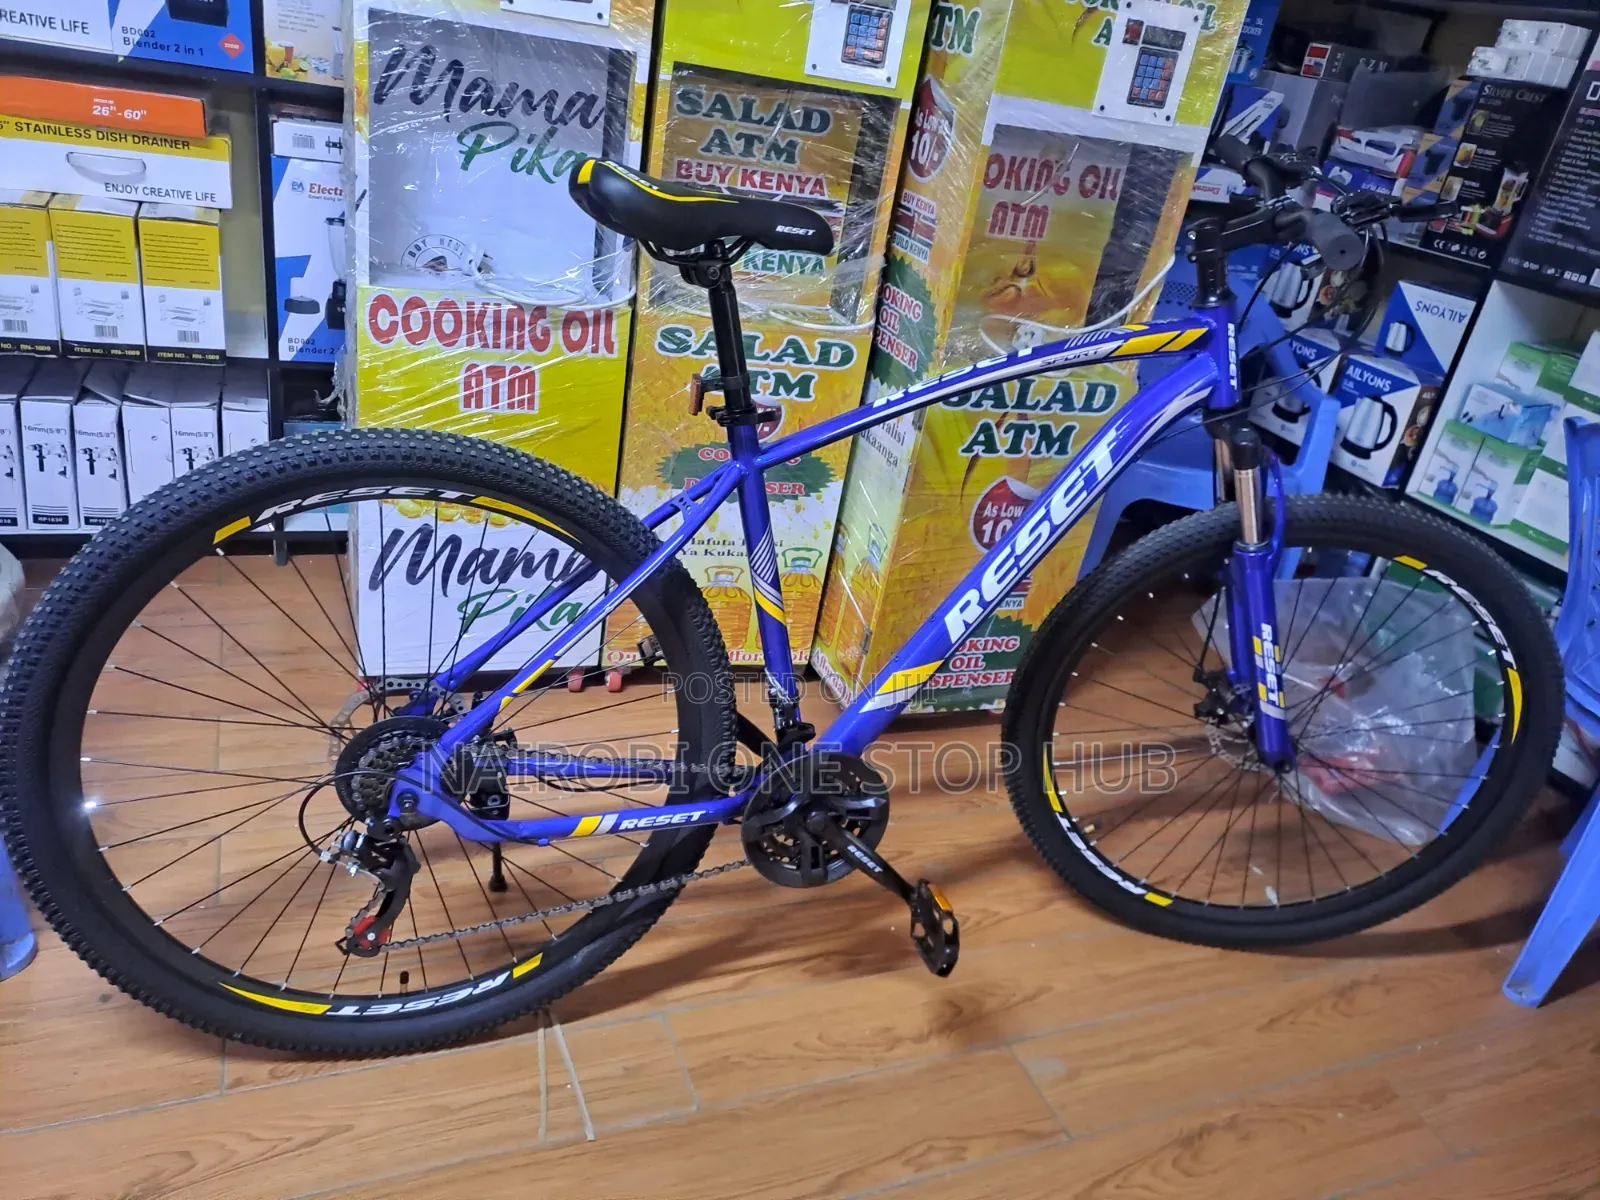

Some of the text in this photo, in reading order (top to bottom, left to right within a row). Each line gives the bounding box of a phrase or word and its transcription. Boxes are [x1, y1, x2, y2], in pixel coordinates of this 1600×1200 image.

[60, 18, 90, 35] LIFE
[121, 25, 156, 38] BD002
[932, 7, 976, 53] TM
[123, 36, 204, 56] Blender 2 in 1
[373, 44, 607, 130] Mama
[676, 87, 834, 134] SALAD
[15, 121, 92, 140] STAINLESS
[96, 130, 128, 143] DISH
[132, 134, 190, 150] DRAINER
[699, 128, 803, 165] ATM
[911, 130, 939, 170] 10/-
[105, 183, 217, 204] ENJOY CREATIVE LIFE
[675, 159, 829, 198] BUY KENYA
[917, 197, 935, 215] KENYA
[988, 201, 1049, 238] ATM
[775, 225, 816, 236] RESET
[743, 251, 827, 275] KENYA
[877, 283, 922, 321] OKING
[1415, 299, 1468, 324] AILYONS
[368, 294, 618, 355] COOKING OIL
[880, 308, 899, 333] OIL
[288, 337, 316, 346] BD002
[288, 345, 336, 355] Blender 2
[1039, 346, 1102, 367] SPORT
[1227, 322, 1238, 391] RESET
[463, 362, 538, 411] ATM
[1346, 364, 1393, 392] AILYONS
[961, 420, 1079, 457] ATM
[254, 485, 476, 523] RESET
[983, 501, 1025, 518] As Low
[944, 426, 1126, 644] RESET
[1000, 599, 1023, 611] ENYA
[1422, 569, 1517, 670] RESET
[951, 656, 984, 670] OIL
[1261, 622, 1279, 706] RESET
[620, 809, 705, 831] RESET
[1055, 811, 1147, 895] RESET
[325, 970, 511, 1016] RESET
